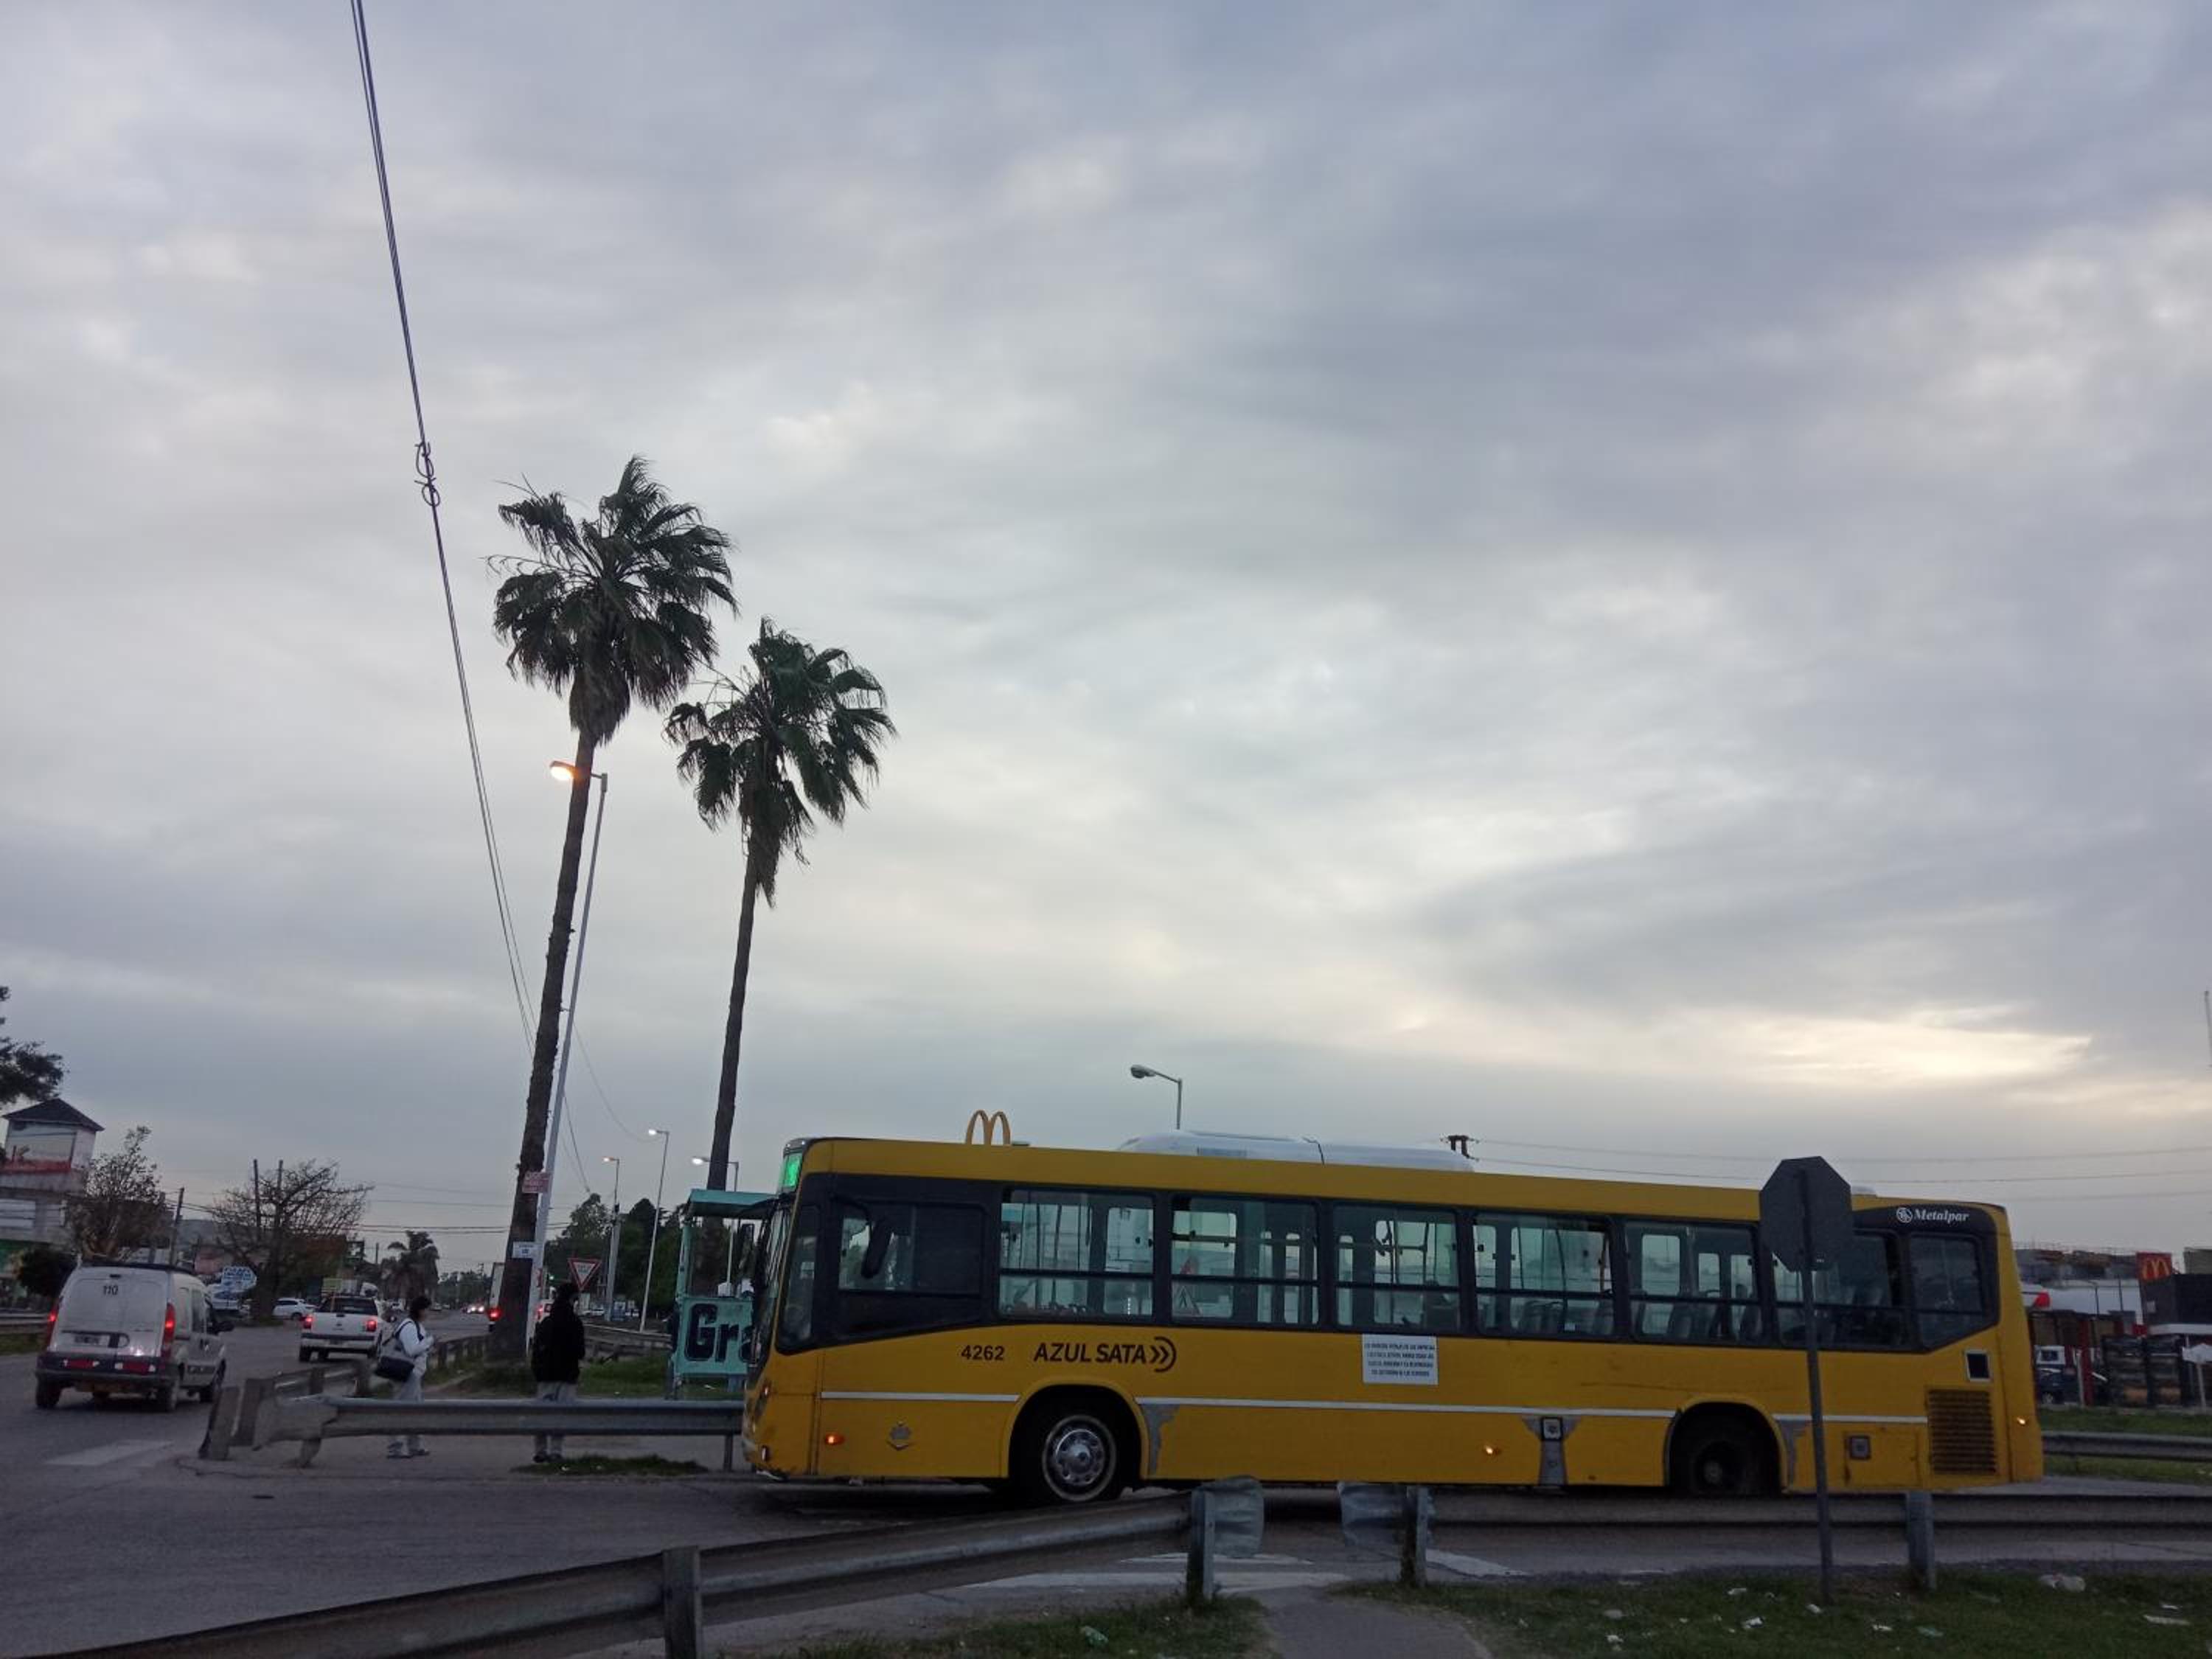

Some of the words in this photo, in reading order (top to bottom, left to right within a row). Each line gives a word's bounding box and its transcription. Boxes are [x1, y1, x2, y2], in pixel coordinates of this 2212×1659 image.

[1914, 1208, 1969, 1224] Metalpar
[102, 1284, 119, 1295] 110
[961, 1343, 1005, 1361] 4262
[1034, 1343, 1091, 1363] AZUL
[1095, 1343, 1147, 1364] SATA
